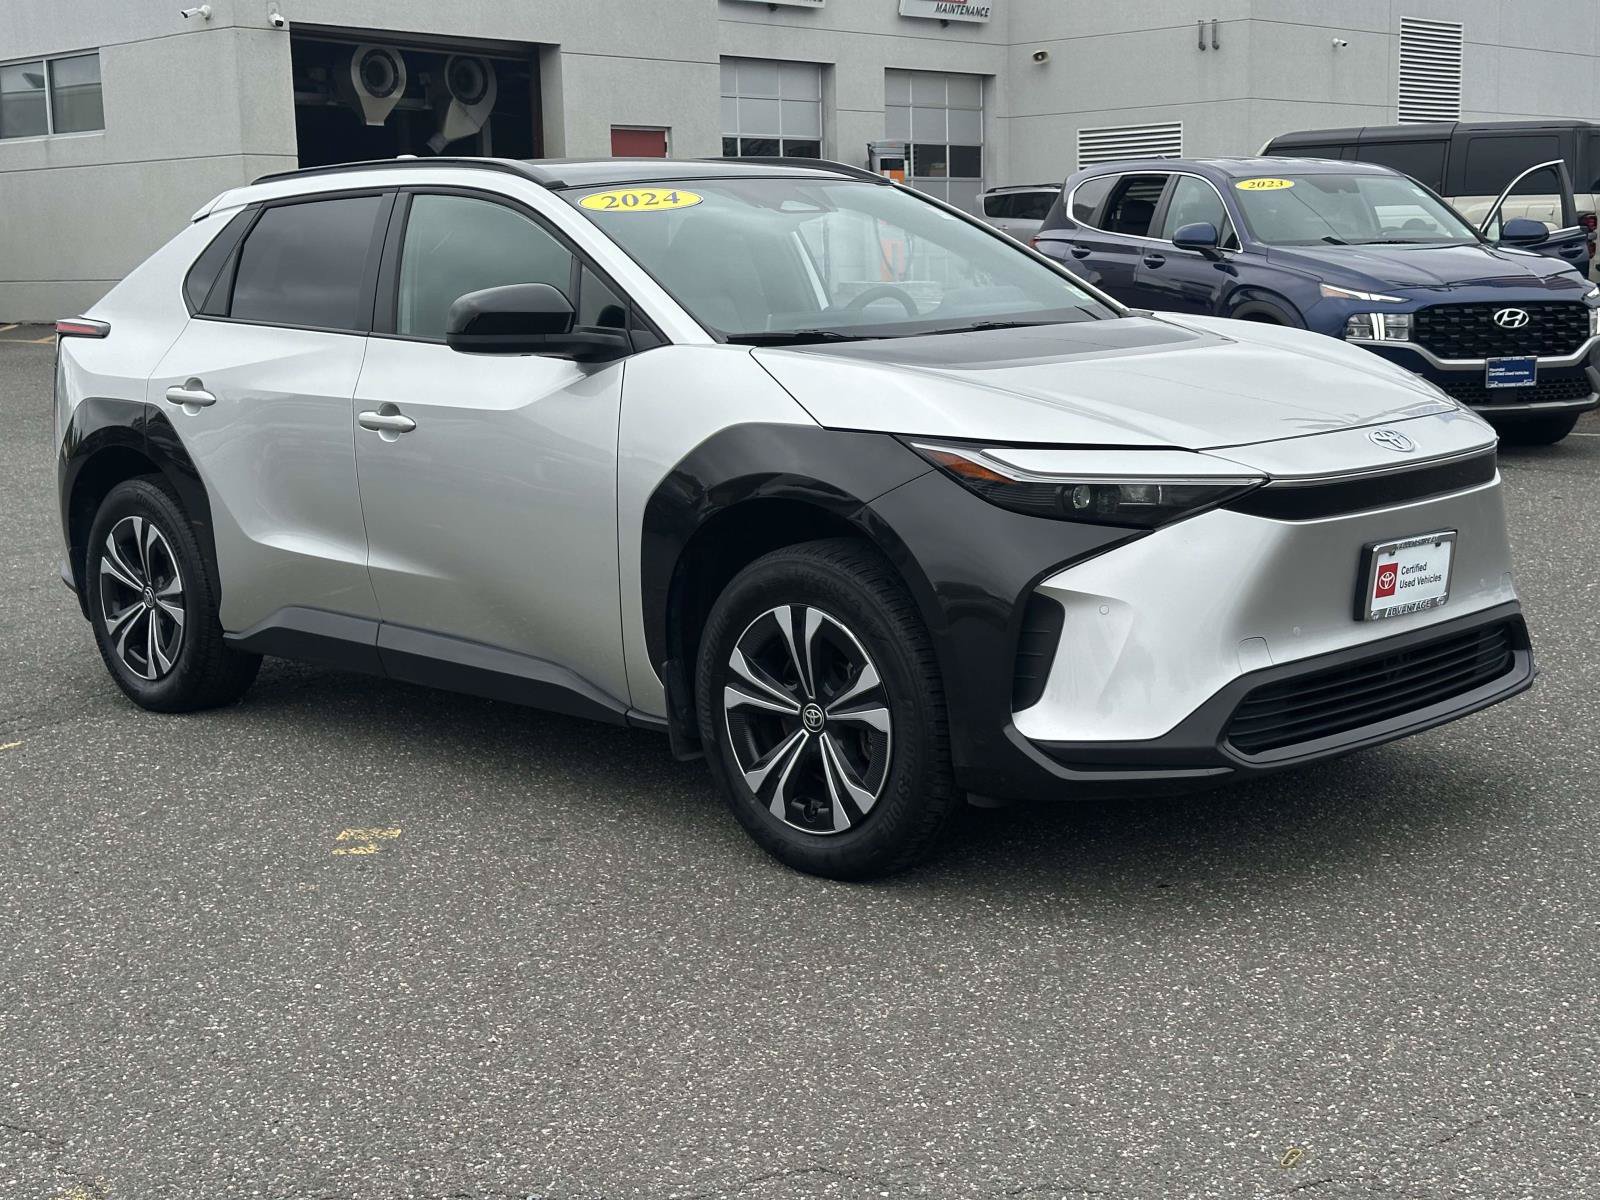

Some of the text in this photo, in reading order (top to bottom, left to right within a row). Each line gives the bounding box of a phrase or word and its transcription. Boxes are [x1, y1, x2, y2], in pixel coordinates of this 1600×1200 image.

[935, 2, 990, 18] MAINTENANCE
[1248, 180, 1284, 189] 2023
[601, 191, 680, 210] 2024
[1401, 561, 1428, 575] Certified
[1400, 573, 1442, 589] Used Vehicles
[1385, 600, 1431, 617] ADVANTAGE
